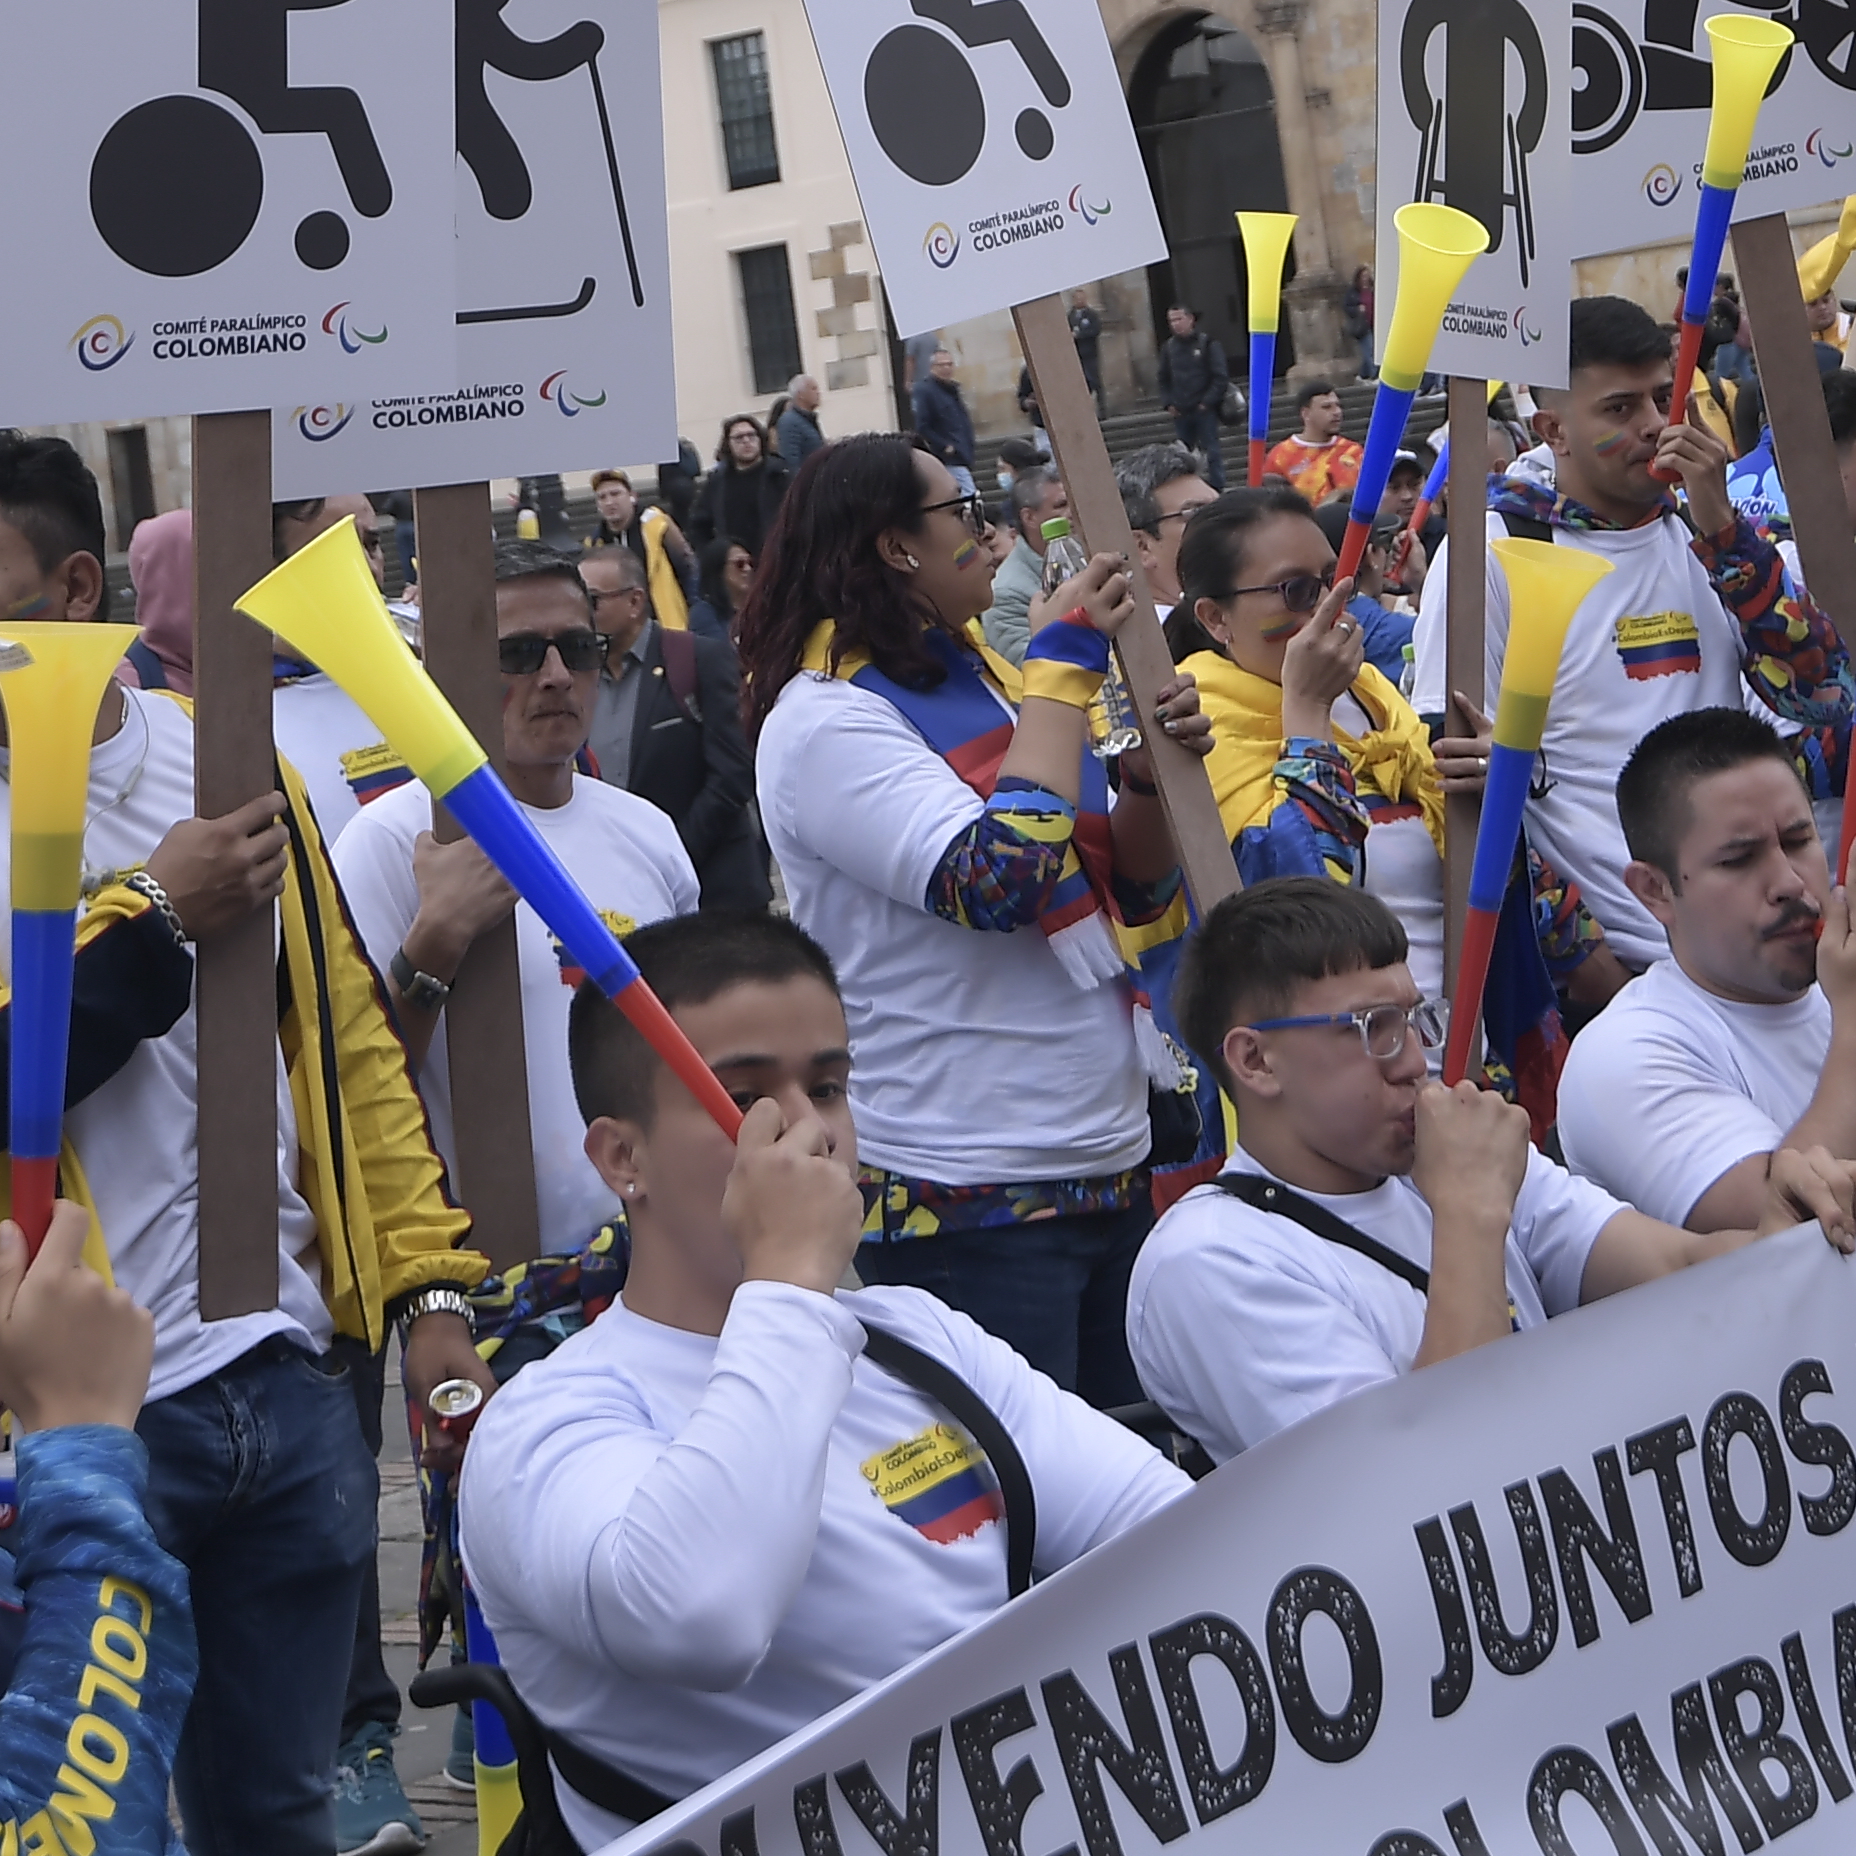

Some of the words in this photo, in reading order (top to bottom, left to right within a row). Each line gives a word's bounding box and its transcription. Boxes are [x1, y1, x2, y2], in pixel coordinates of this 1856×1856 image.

[969, 212, 1001, 234] COMITÉ
[1003, 200, 1060, 223] PARALÍMPICO
[973, 214, 1065, 252] COLOMBIANO
[152, 317, 206, 335] COMITÉ
[210, 311, 306, 332] PARALÍMPICO
[1442, 316, 1508, 339] COLOMBIANO
[152, 332, 307, 360] COLOMBIANO
[372, 399, 525, 429] COLOMBIANO
